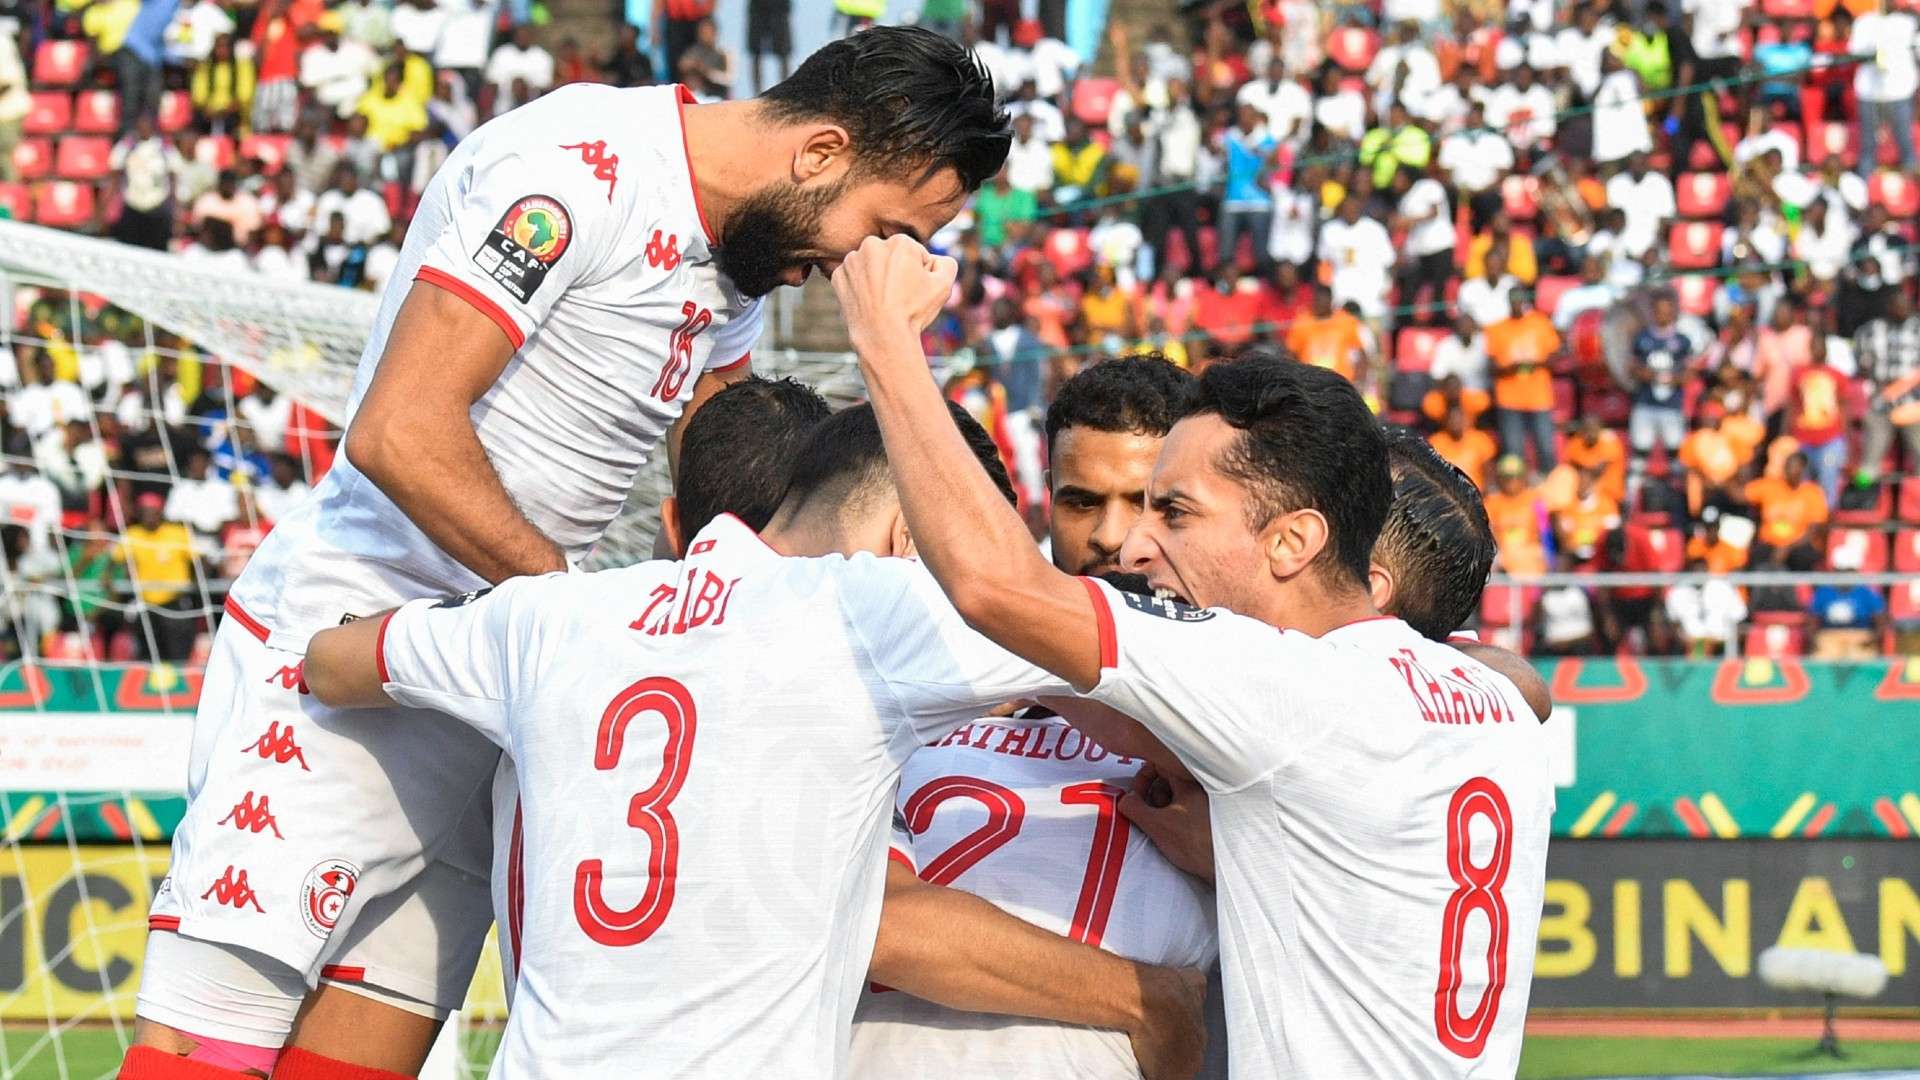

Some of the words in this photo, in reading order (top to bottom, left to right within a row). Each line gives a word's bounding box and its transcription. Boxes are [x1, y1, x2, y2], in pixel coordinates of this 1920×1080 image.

[501, 239, 540, 269] CAF
[651, 301, 711, 402] 18
[574, 677, 697, 946] 3
[903, 776, 1131, 948] 21
[1436, 777, 1512, 1058] 8
